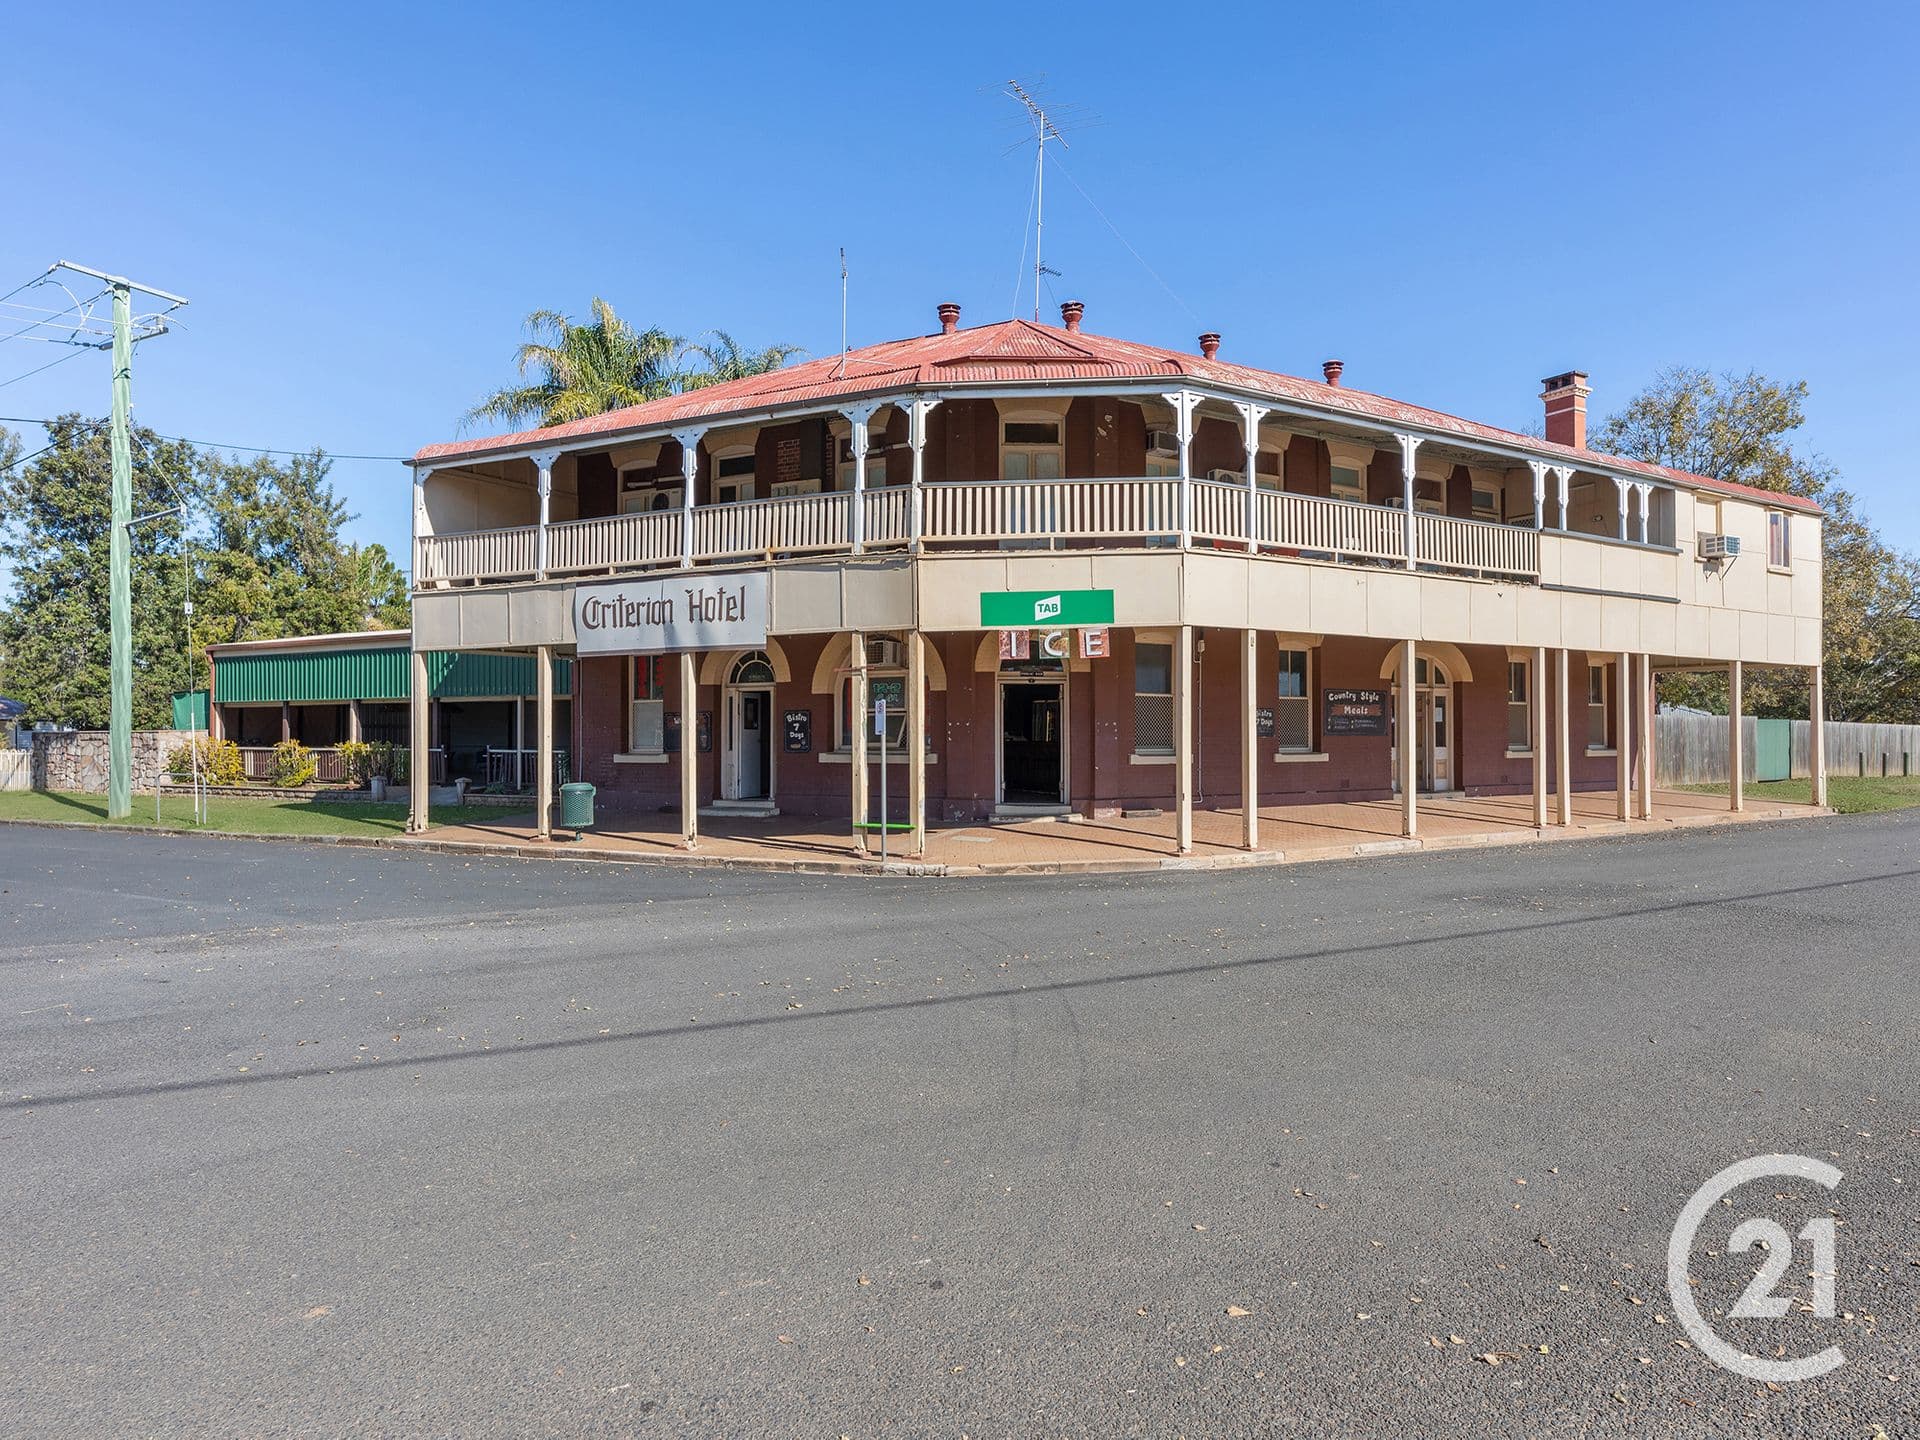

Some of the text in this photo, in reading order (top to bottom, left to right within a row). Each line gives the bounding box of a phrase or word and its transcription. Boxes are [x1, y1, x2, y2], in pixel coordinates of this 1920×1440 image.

[581, 584, 747, 630] Criterion Hotel
[1037, 603, 1059, 613] TAB
[1010, 630, 1104, 657] ICE
[1328, 691, 1379, 703] Country Style
[1344, 705, 1368, 715] Meals
[786, 713, 807, 722] Bistro
[793, 723, 800, 731] 7
